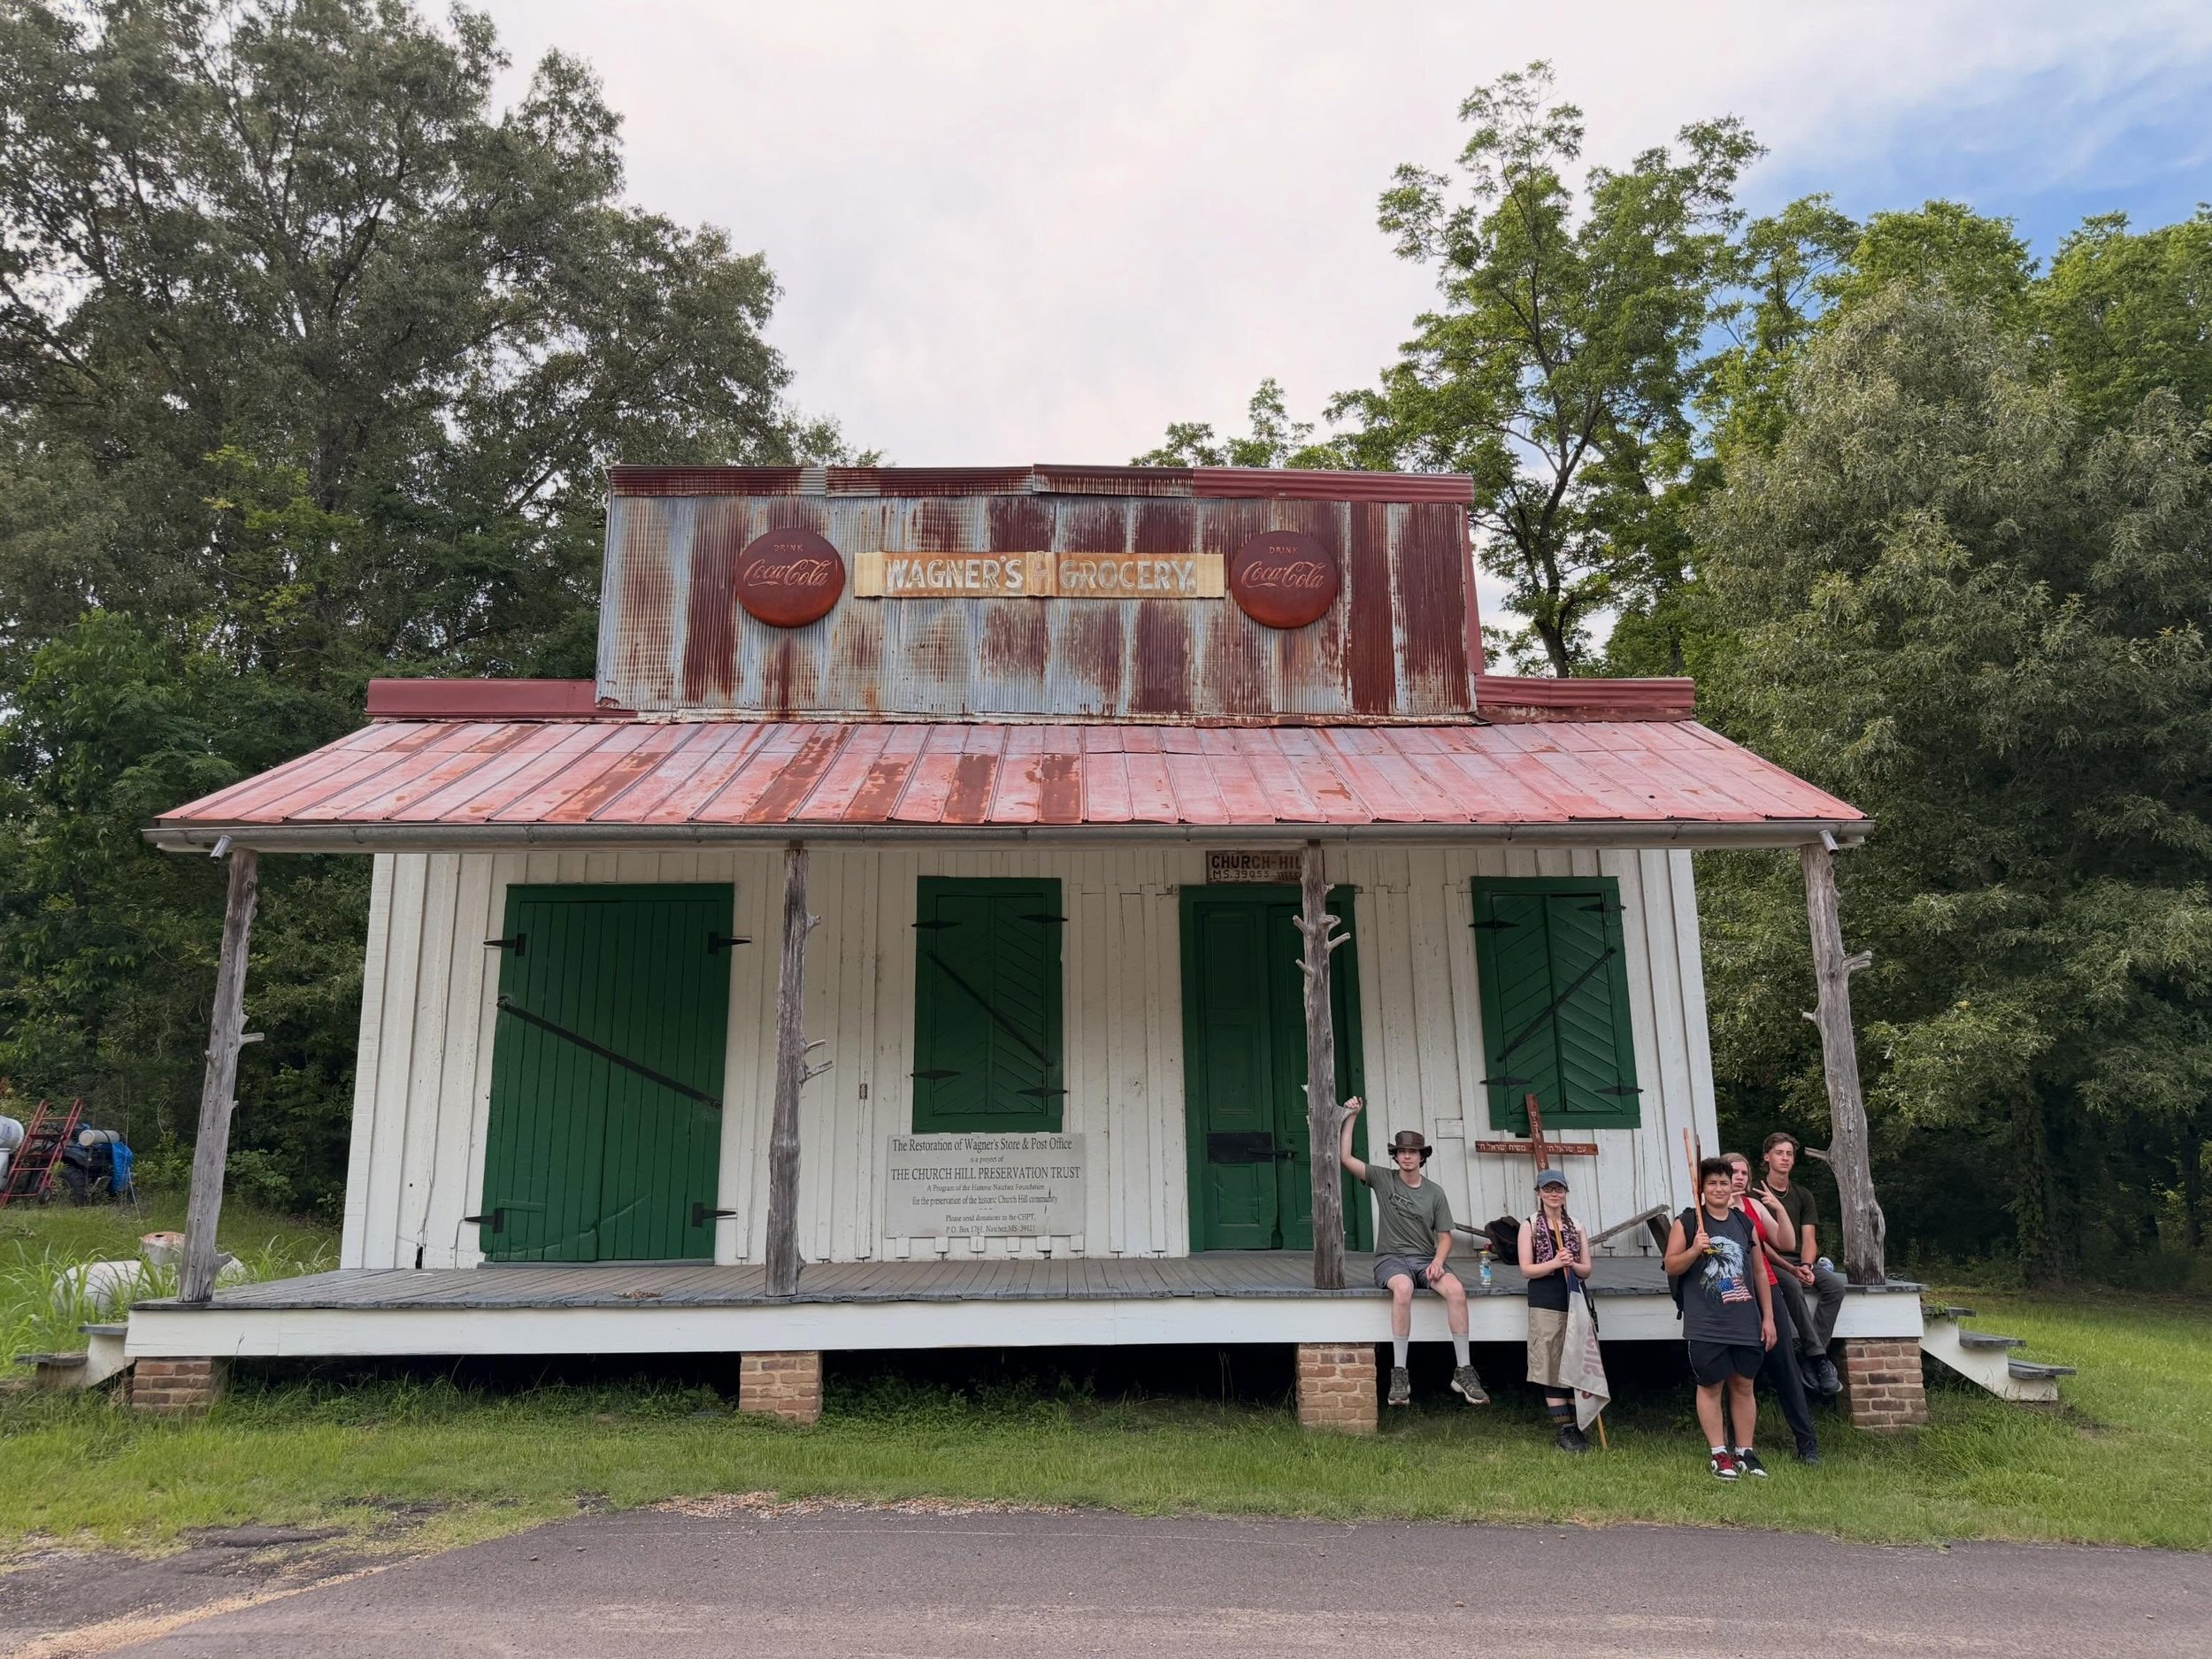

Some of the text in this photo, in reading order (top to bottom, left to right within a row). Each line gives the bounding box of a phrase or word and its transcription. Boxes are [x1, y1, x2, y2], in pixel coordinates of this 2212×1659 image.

[772, 543, 803, 553] DRINK
[1269, 546, 1299, 555] DRINK
[886, 555, 1024, 589] WAGNER'S
[892, 1136, 1072, 1154] The Restoration of Wagner's Store & Post Office
[891, 1166, 1081, 1180] THE CHURCH HILL PRESERVATION TRUST
[933, 1184, 955, 1194] Program
[930, 1196, 962, 1207] preservation
[962, 1194, 969, 1204] of
[978, 1194, 997, 1204] historic
[997, 1194, 1018, 1204] Church
[1018, 1194, 1028, 1203] Hill
[1029, 1195, 1058, 1204] community
